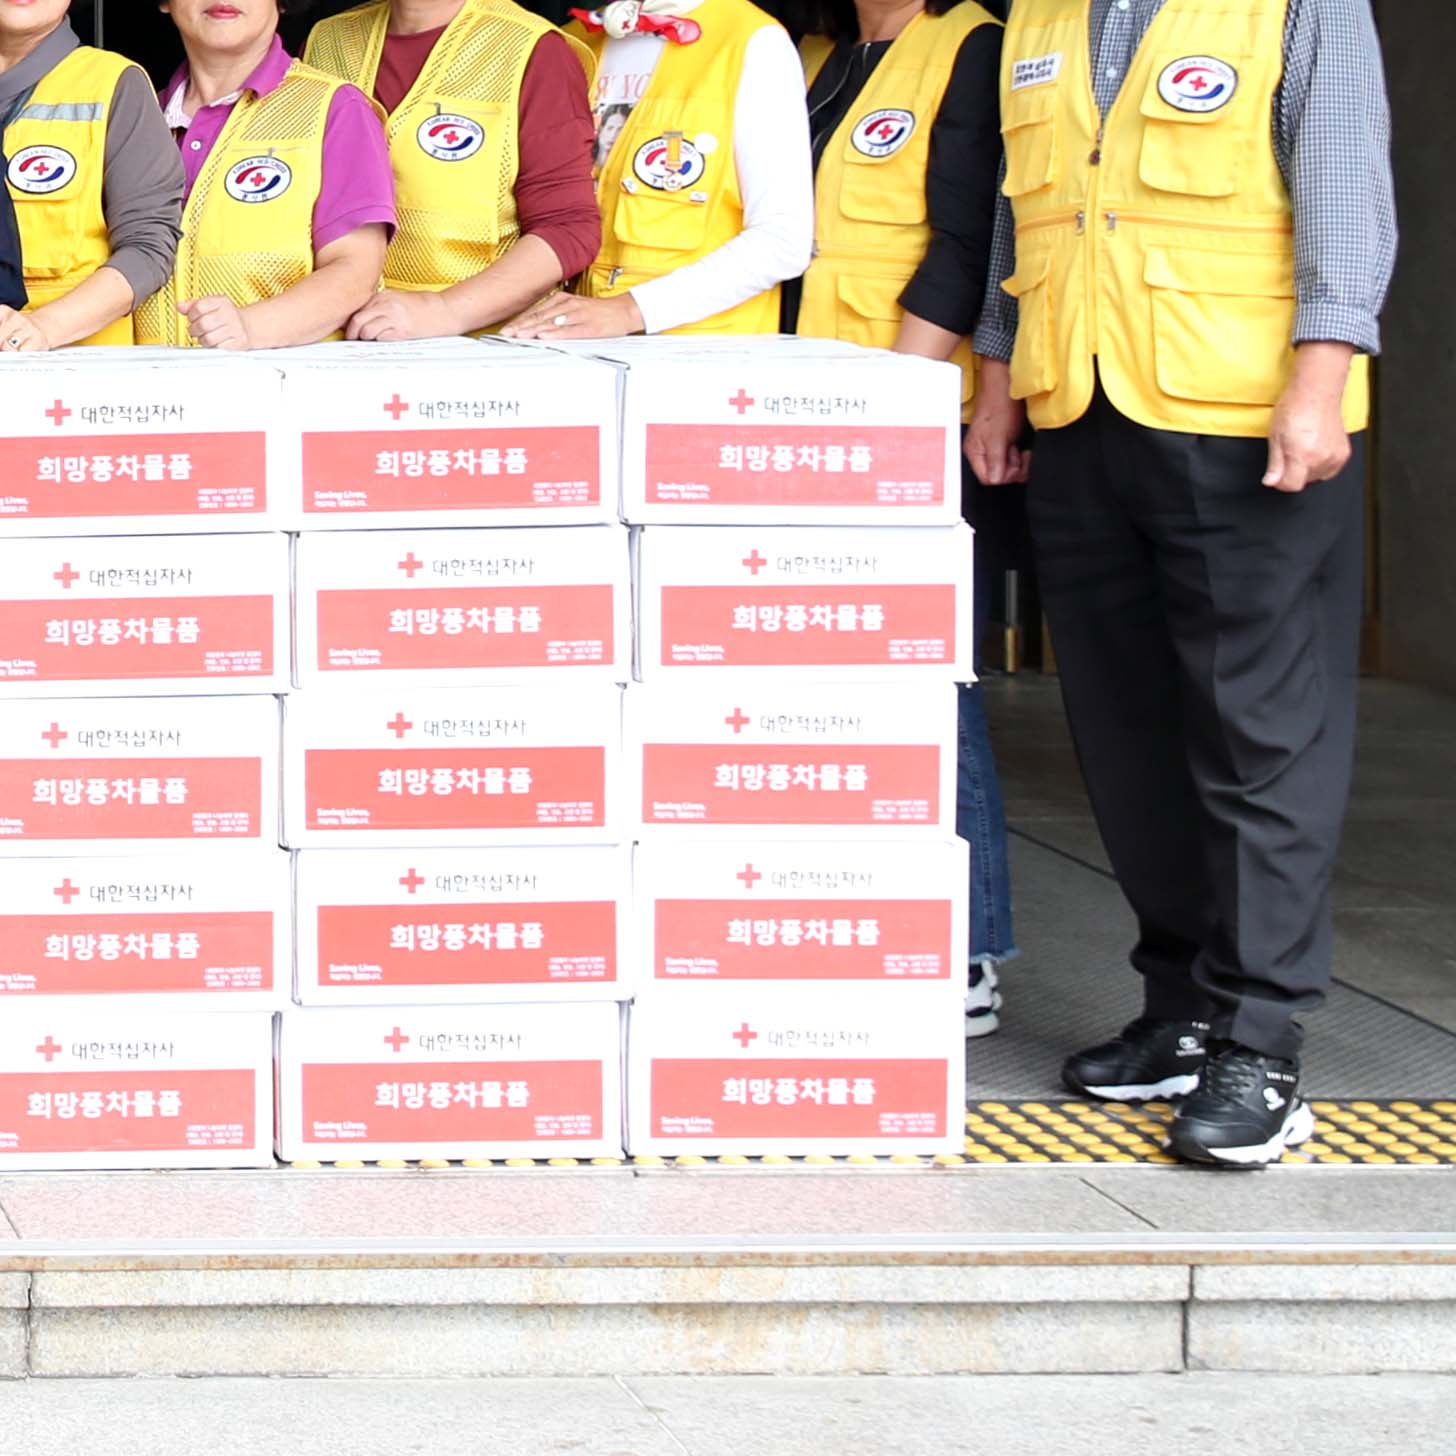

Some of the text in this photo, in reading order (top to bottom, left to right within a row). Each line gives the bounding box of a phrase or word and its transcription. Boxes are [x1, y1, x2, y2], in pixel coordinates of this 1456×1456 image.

[81, 404, 185, 424] 대한적십자사
[418, 400, 520, 419] 대한적십자사
[764, 396, 867, 415] 대한적십자사
[36, 453, 193, 483] 희망풍차물품
[375, 447, 528, 477] 희망풍차물품
[718, 444, 873, 473] 희망풍차물품
[89, 568, 192, 587] 대한적십자사
[435, 558, 537, 577] 대한적십자사
[779, 556, 881, 575] 대한적십자사
[388, 606, 542, 635] 희망풍차물품
[732, 604, 885, 632] 희망풍차물품
[44, 616, 201, 646] 희망풍차물품
[423, 719, 525, 738] 대한적십자사
[760, 715, 862, 734] 대한적십자사
[77, 729, 181, 748] 대한적십자사
[377, 767, 533, 796] 희망풍차물품
[714, 763, 868, 791] 희망풍차물품
[32, 777, 188, 806] 희망풍차물품
[435, 874, 537, 892] 대한적십자사
[773, 871, 875, 890] 대한적십자사
[89, 884, 193, 903] 대한적십자사
[389, 922, 545, 951] 희망풍차물품
[726, 918, 881, 946] 희망풍차물품
[44, 932, 200, 961] 희망풍차물품
[71, 1041, 174, 1060] 대한적십자사
[419, 1033, 521, 1051] 대한적십자사
[768, 1030, 870, 1049] 대한적십자사
[374, 1080, 530, 1109] 희망풍차물품
[722, 1077, 876, 1105] 희망풍차물품
[27, 1090, 183, 1119] 희망풍차물품
